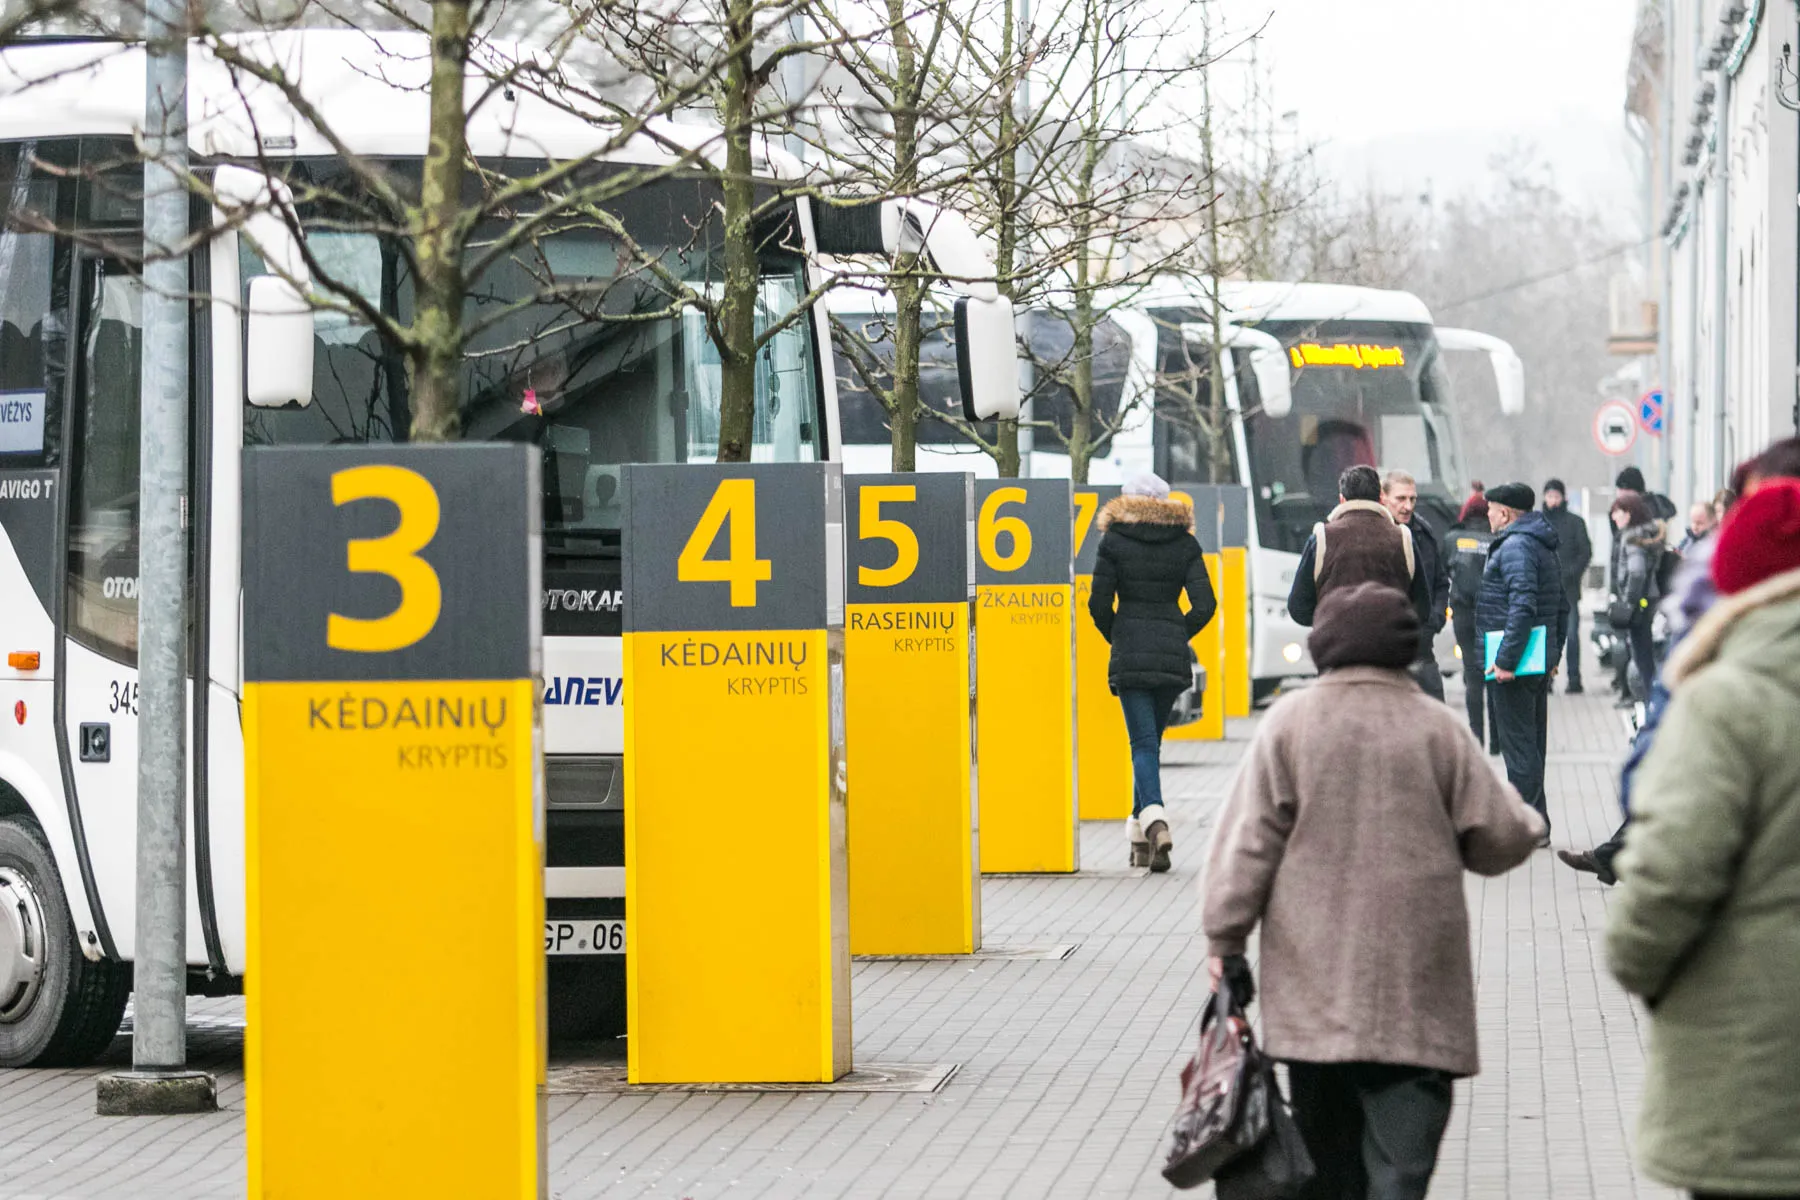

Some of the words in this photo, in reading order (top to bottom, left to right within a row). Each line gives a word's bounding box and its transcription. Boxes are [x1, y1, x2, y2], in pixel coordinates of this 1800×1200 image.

[0, 479, 41, 499] AVIGO
[858, 485, 919, 587] 5
[977, 486, 1032, 572] 6
[1074, 492, 1098, 559] 7
[326, 464, 442, 653] 3
[677, 478, 772, 607] 4
[851, 611, 955, 634] RASEINIŲ
[1010, 613, 1061, 625] KRYPTIS
[661, 637, 807, 671] KĖDAINIŲ
[894, 638, 955, 652] KRYPTIS
[543, 676, 623, 706] ANEV
[727, 677, 808, 696] KRYPTIS
[308, 690, 508, 737] KĖDAINIŲ
[397, 744, 508, 770] KRYPTIS
